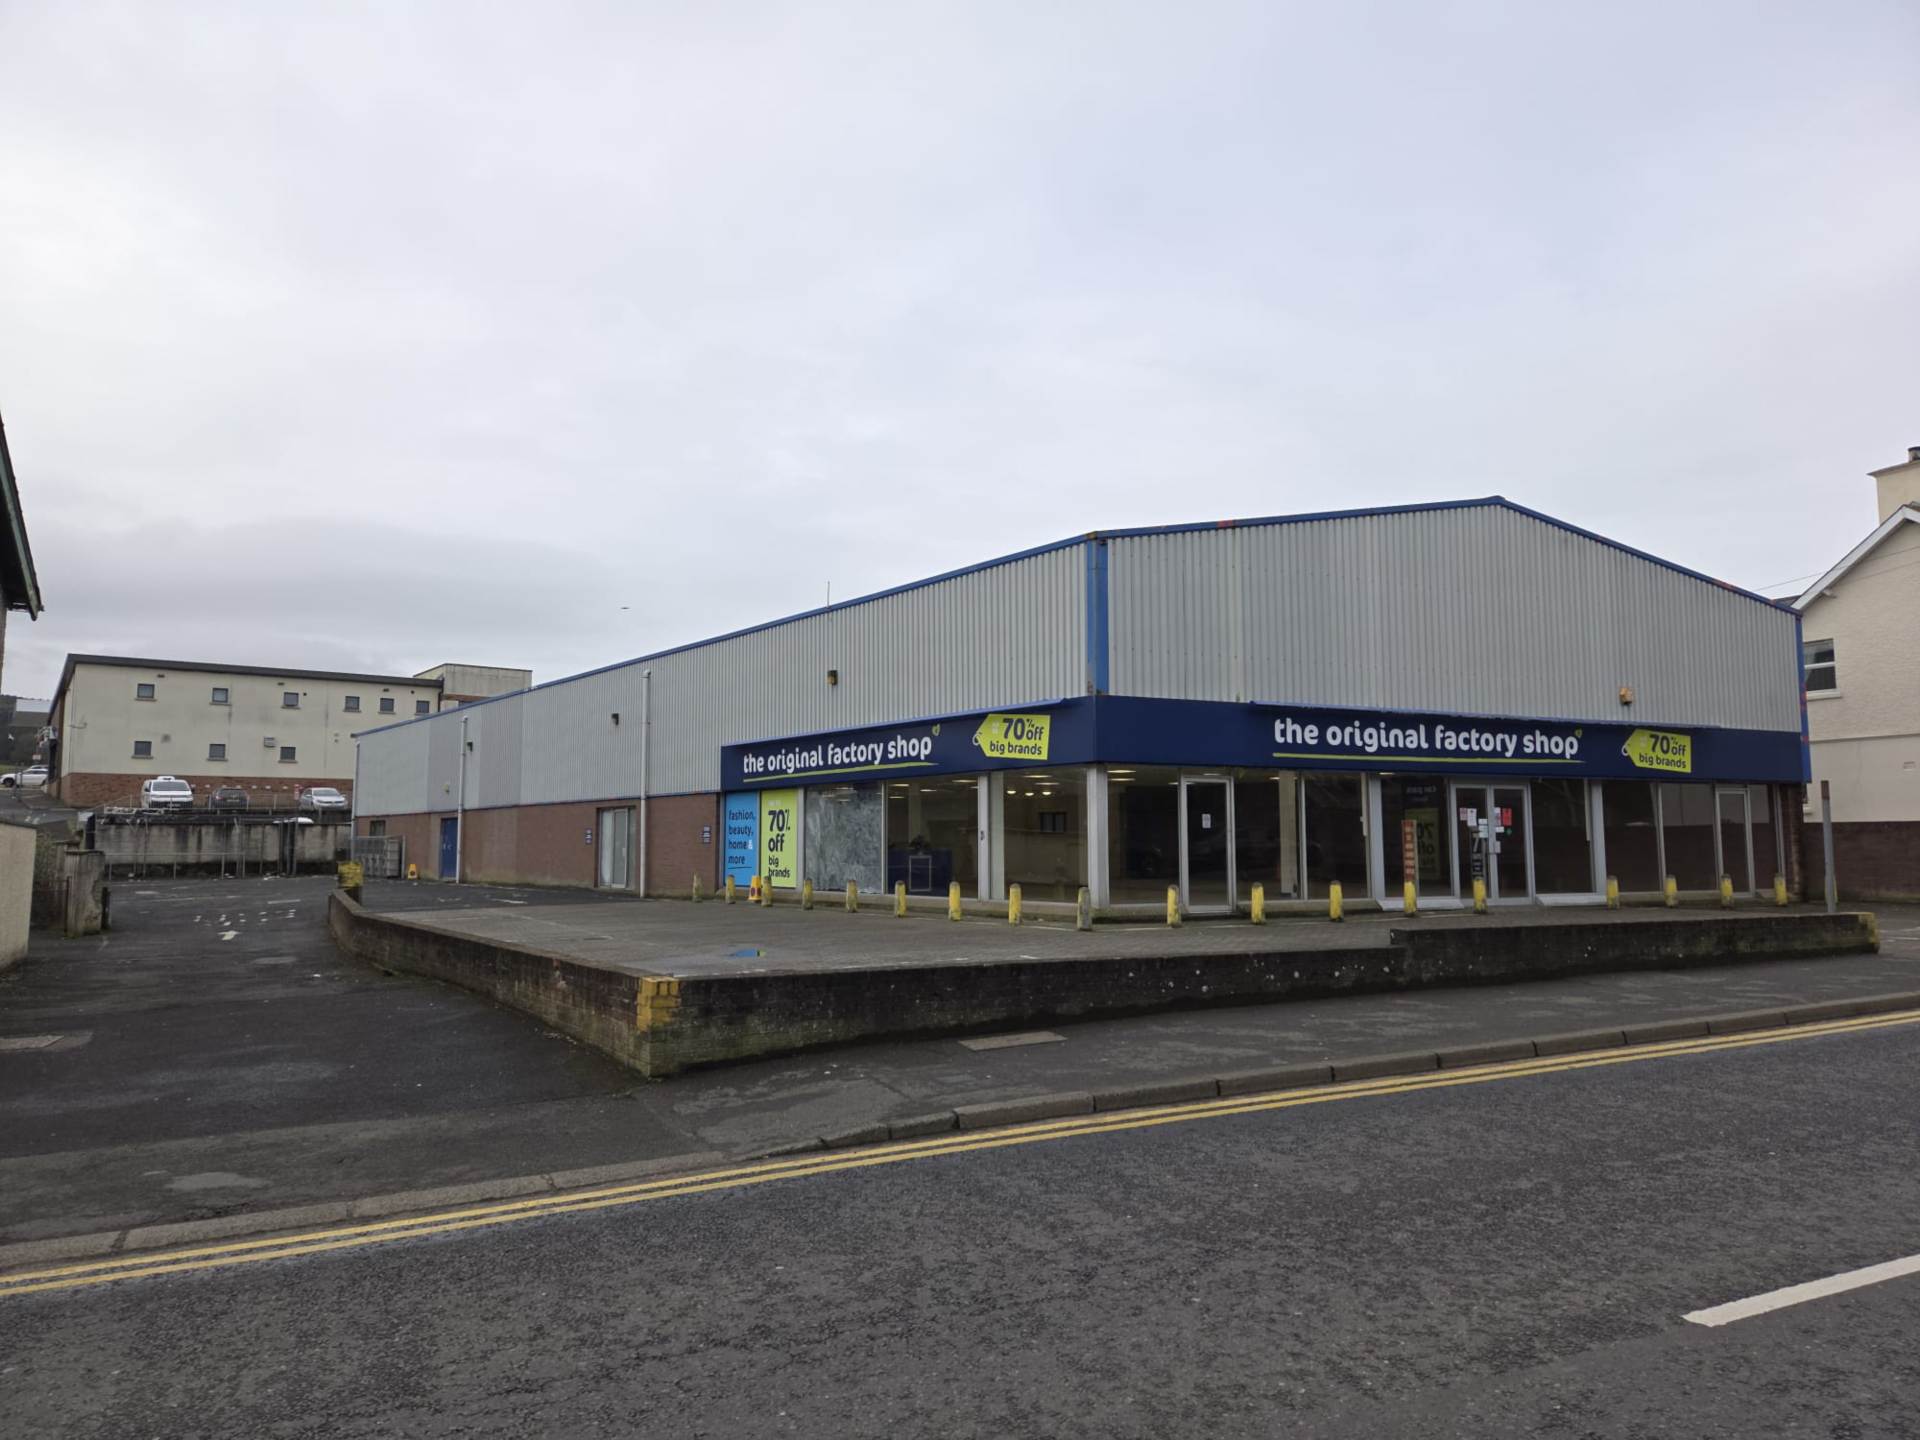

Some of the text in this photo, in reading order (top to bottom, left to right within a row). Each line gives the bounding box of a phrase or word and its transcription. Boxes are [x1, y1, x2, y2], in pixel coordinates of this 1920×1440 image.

[1026, 726, 1044, 740] off
[1274, 717, 1579, 759] the original factory shop
[743, 735, 932, 774] the original factory shop
[990, 740, 1042, 755] big brands
[1671, 744, 1686, 756] off
[1639, 753, 1686, 768] big brands
[768, 809, 790, 832] 70%
[728, 825, 753, 837] beauty,
[728, 840, 746, 849] home
[768, 834, 784, 852] off
[728, 855, 745, 864] more
[768, 855, 779, 867] big
[768, 867, 790, 878] brands
